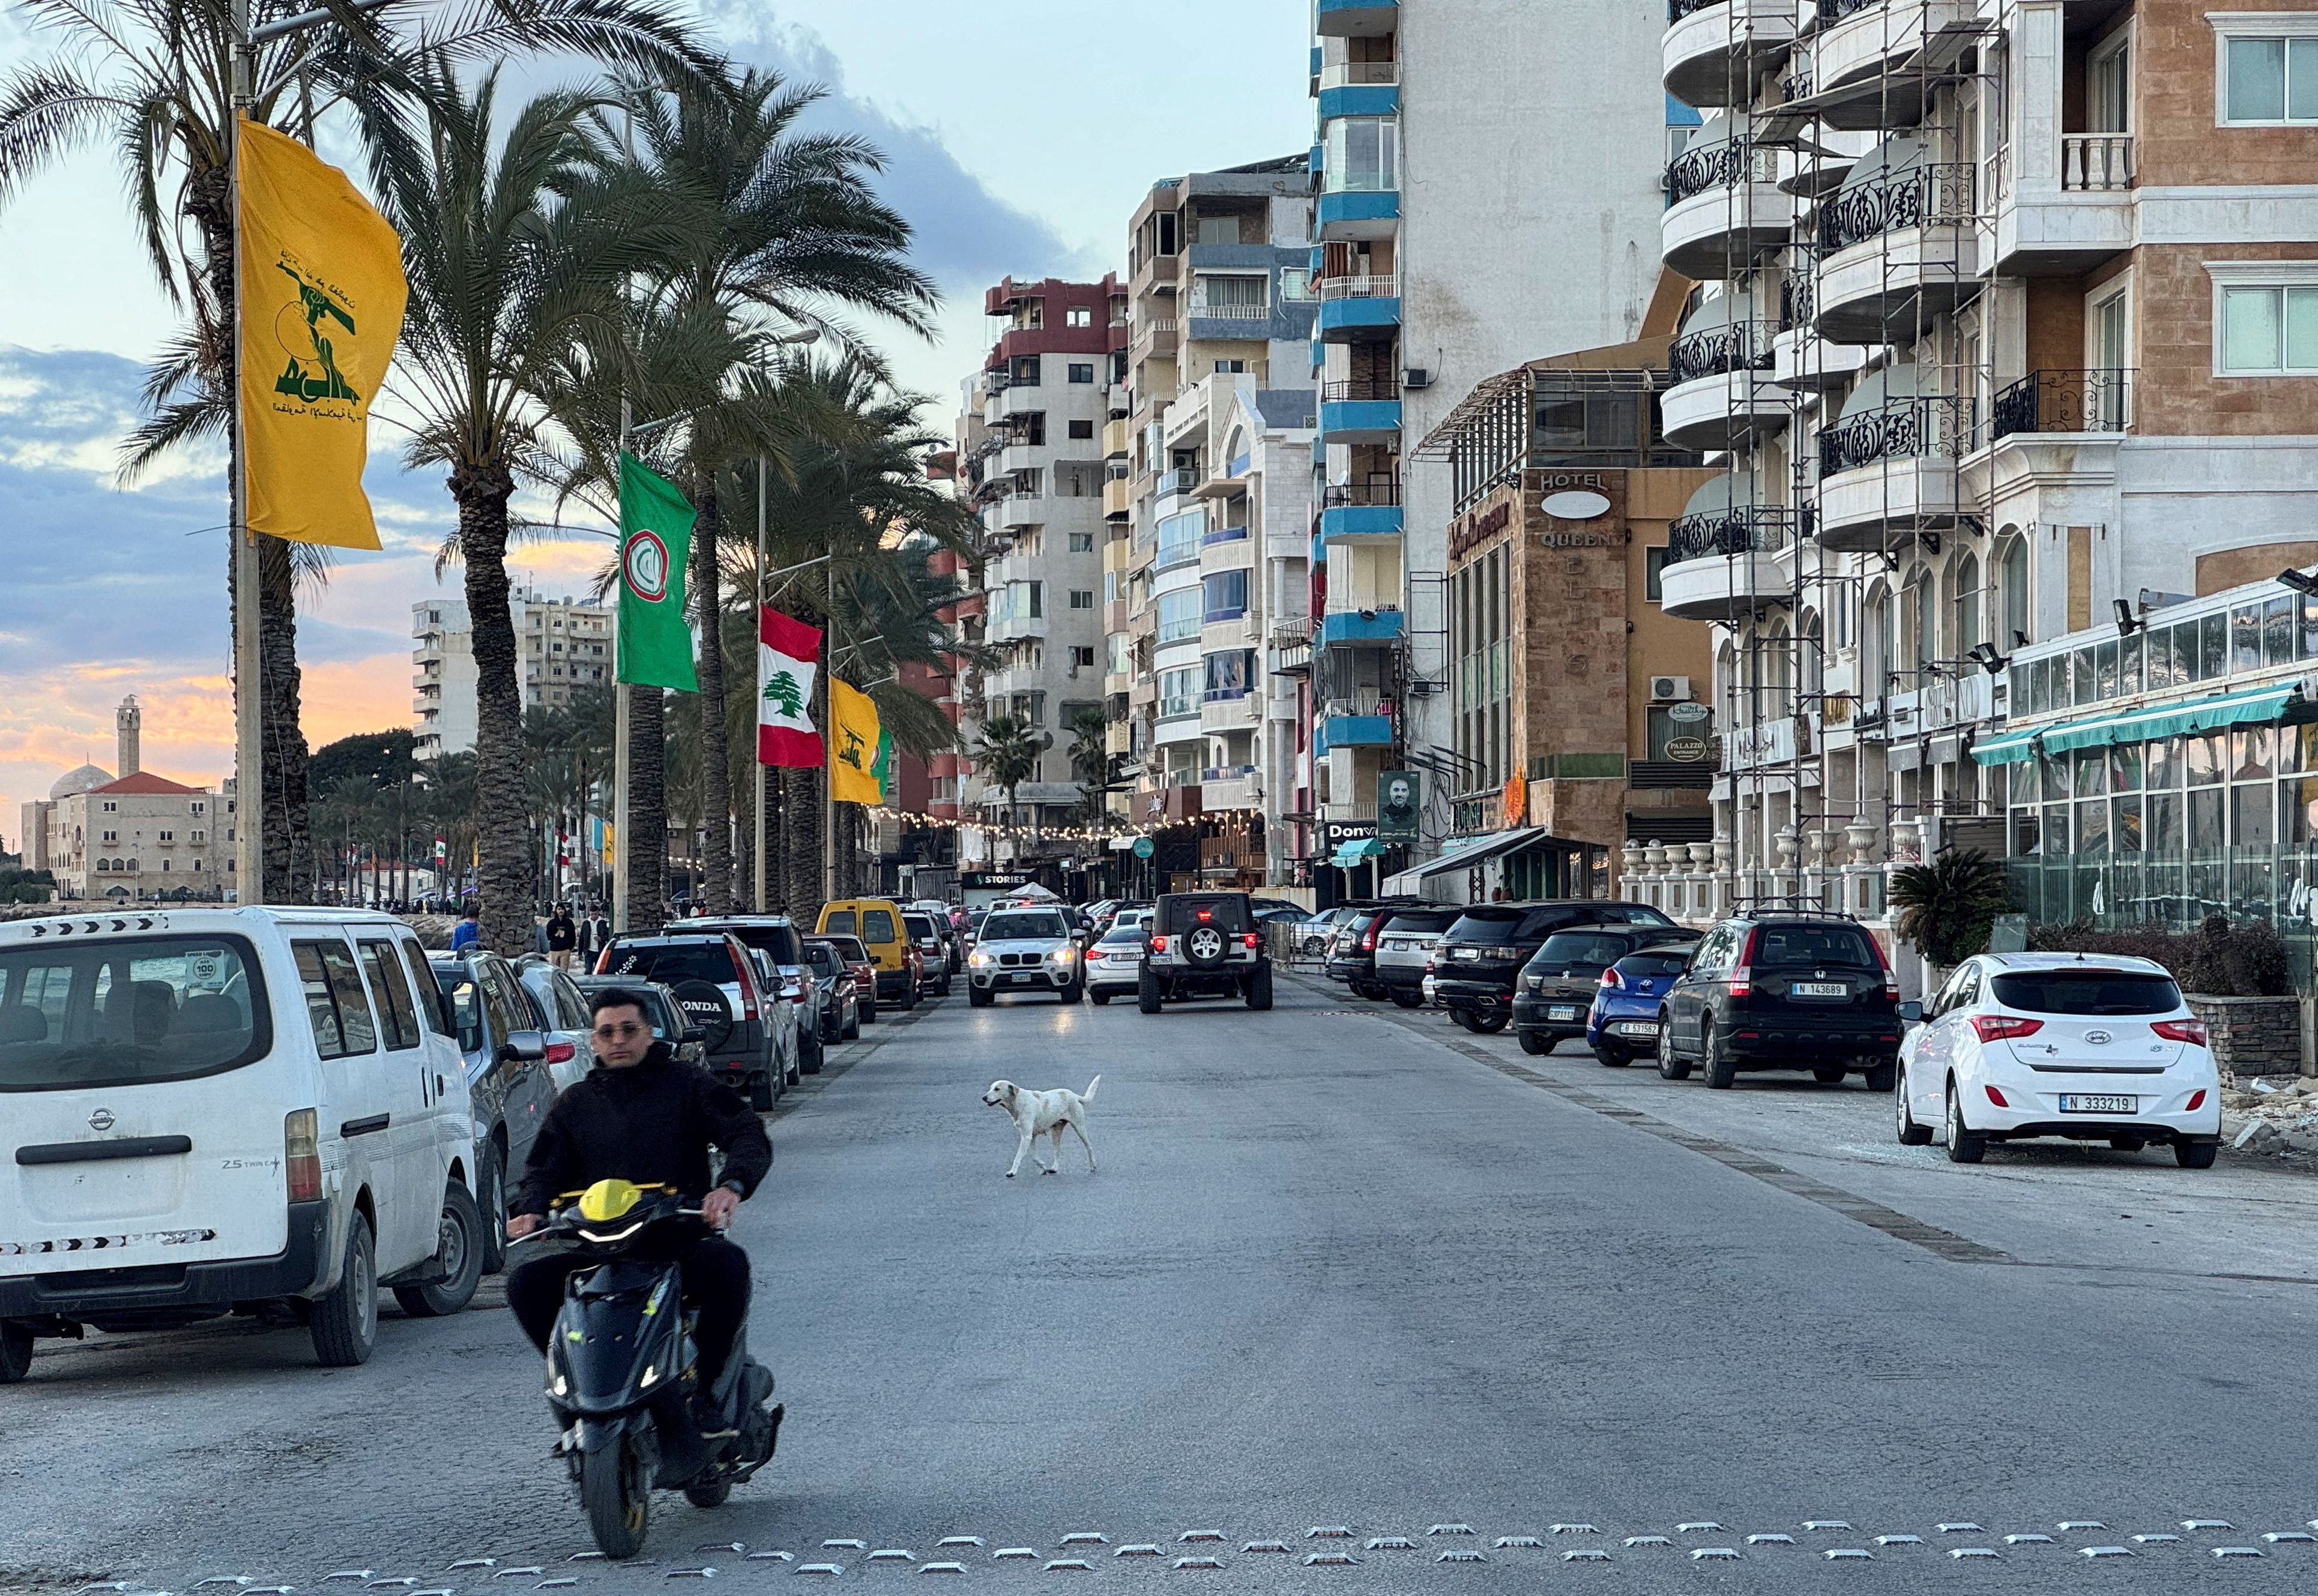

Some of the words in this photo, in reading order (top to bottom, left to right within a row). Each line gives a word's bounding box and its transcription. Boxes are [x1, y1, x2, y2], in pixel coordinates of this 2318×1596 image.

[1541, 474, 1609, 491] HOTEL
[1541, 532, 1610, 547] QUEEN
[985, 876, 1026, 884] STORIES
[1800, 984, 1805, 993] N
[1811, 985, 1841, 994] 143689
[680, 1001, 722, 1012] ONDA
[1633, 1024, 1656, 1033] 531562
[2070, 1097, 2077, 1109] N
[2085, 1097, 2129, 1110] 333219
